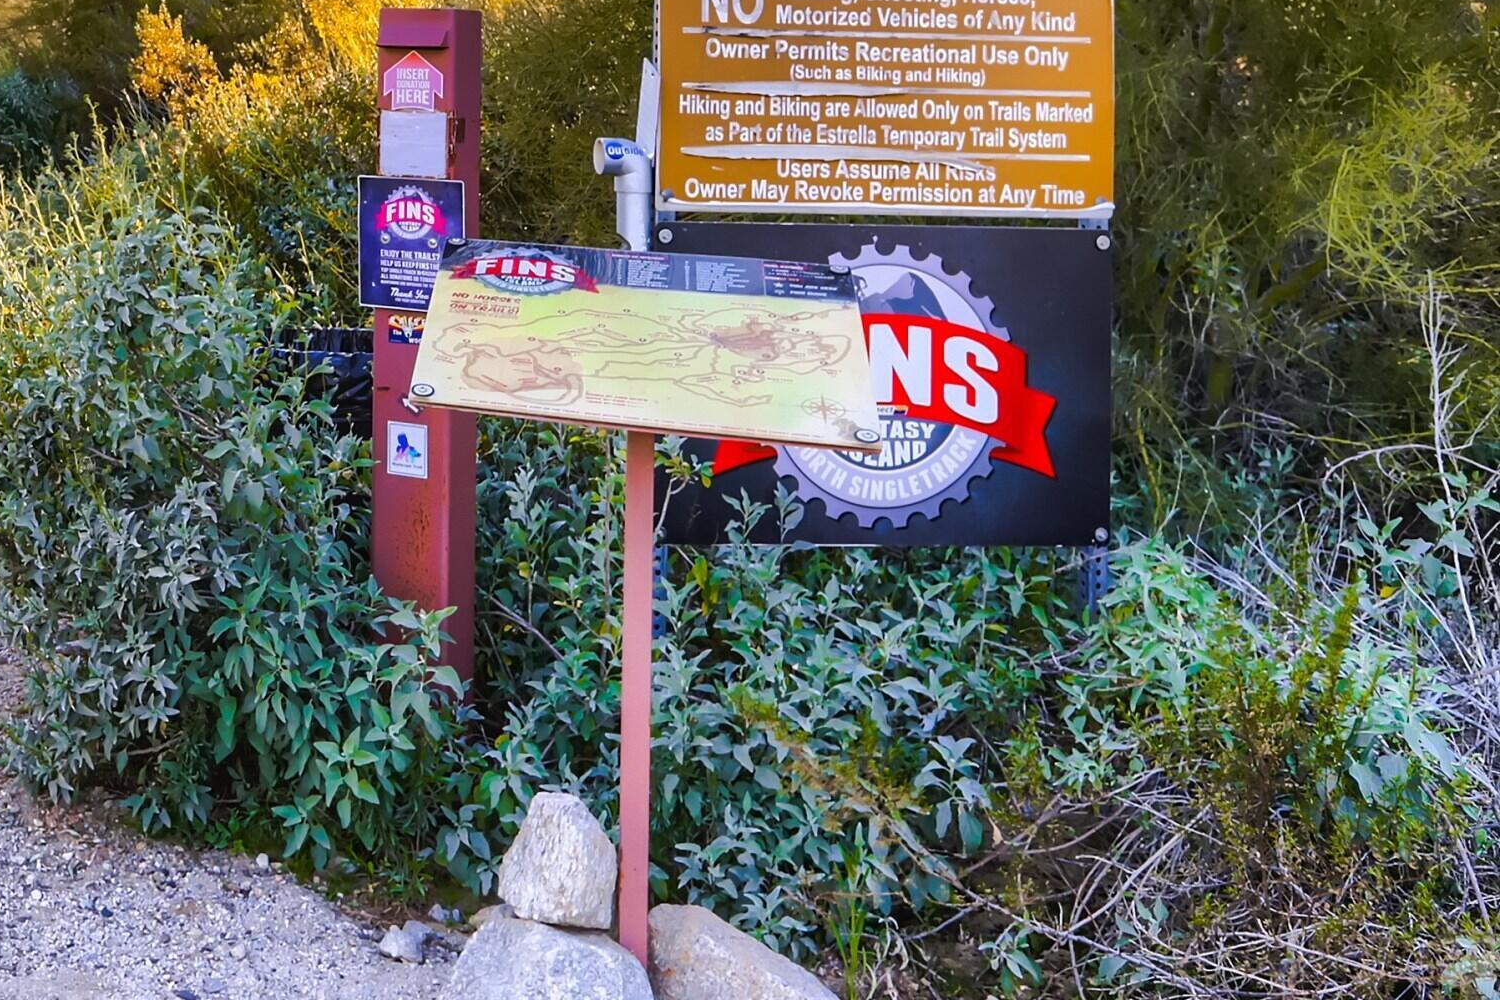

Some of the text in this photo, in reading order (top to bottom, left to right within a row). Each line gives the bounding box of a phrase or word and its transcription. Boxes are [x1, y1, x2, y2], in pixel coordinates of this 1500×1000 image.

[776, 7, 1075, 35] Motorized Vehicles of Any Kind
[706, 38, 1069, 71] Owner Permits Recreational Use Only
[397, 68, 430, 80] INSERT
[397, 80, 430, 88] DONATION
[790, 65, 986, 86] (Such as Biking and Hiking)
[397, 89, 430, 104] HERE
[679, 95, 1092, 124] Hiking and Biking are Allowed Only on Trails Marked
[706, 123, 1067, 153] as Part of the Estrella Temporary Trail System
[777, 159, 831, 178] Users
[835, 160, 910, 180] Assume
[916, 163, 941, 181] All
[685, 178, 1085, 208] Owner May Revoke Permission at Any Time
[386, 200, 435, 225] FINS
[380, 249, 440, 260] ENJOY THE TRAILS?
[475, 259, 576, 282] FINS
[390, 287, 429, 300] Thank You
[869, 324, 999, 424] NS
[880, 420, 936, 439] TASY
[797, 430, 978, 502] ORTH SINGLETRACK
